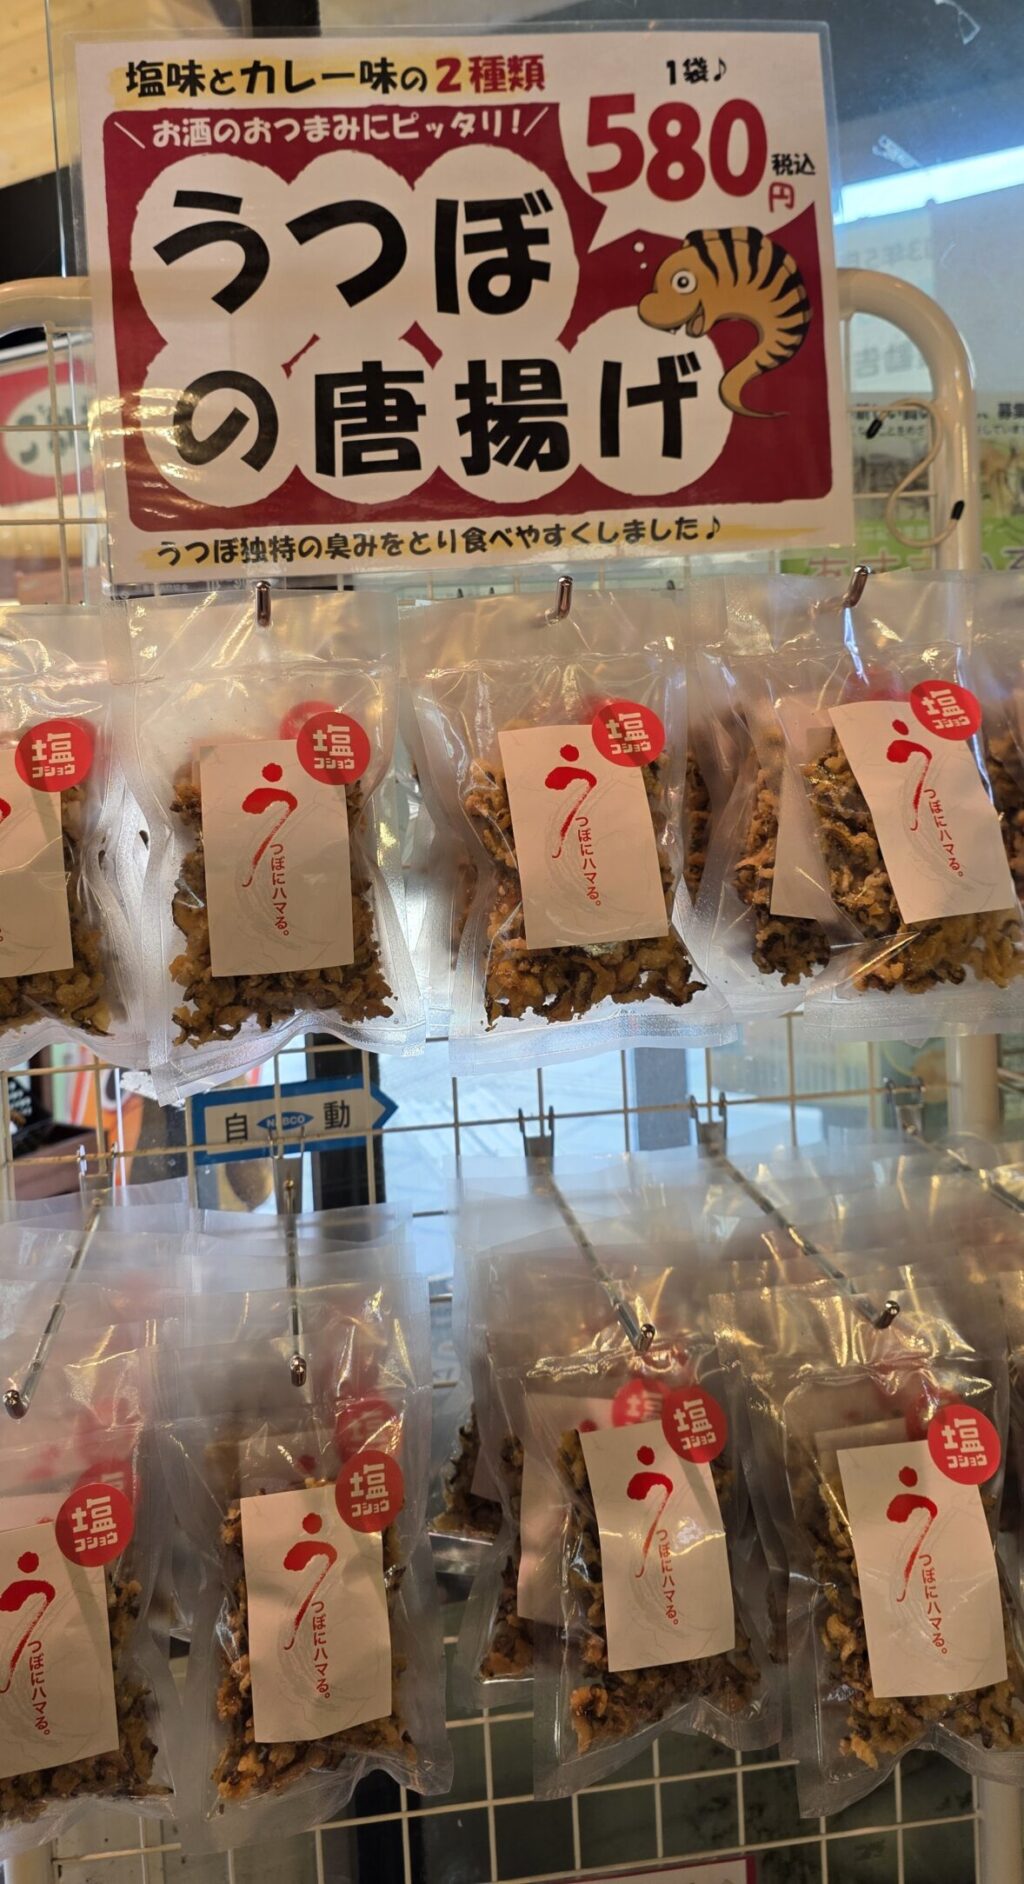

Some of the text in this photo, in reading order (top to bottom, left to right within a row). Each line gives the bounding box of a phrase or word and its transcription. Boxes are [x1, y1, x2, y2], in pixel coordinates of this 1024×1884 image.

[126, 53, 547, 98] 塩味とカレー味の2種類
[586, 92, 796, 214] 580 円
[771, 153, 816, 176] 税込
[153, 188, 553, 316] うつぼ
[171, 351, 703, 479] の唐揚げ
[921, 689, 966, 717] 塩
[605, 712, 649, 742] 塩
[932, 716, 971, 730] コショウ
[32, 732, 75, 764] 塩
[312, 724, 354, 757] 塩
[610, 741, 651, 755] コショウ
[32, 765, 75, 778] コショウ
[313, 757, 355, 770] コショウ
[225, 1099, 350, 1142] 自 NBCO 動
[673, 1398, 712, 1433] 塩
[680, 1431, 717, 1450] コショウ
[941, 1418, 985, 1453] 塩
[946, 1453, 988, 1469] コショウ
[350, 1463, 389, 1500] 塩
[71, 1495, 117, 1534] 塩
[351, 1499, 391, 1518] コショウ
[74, 1532, 118, 1552] コショウ
